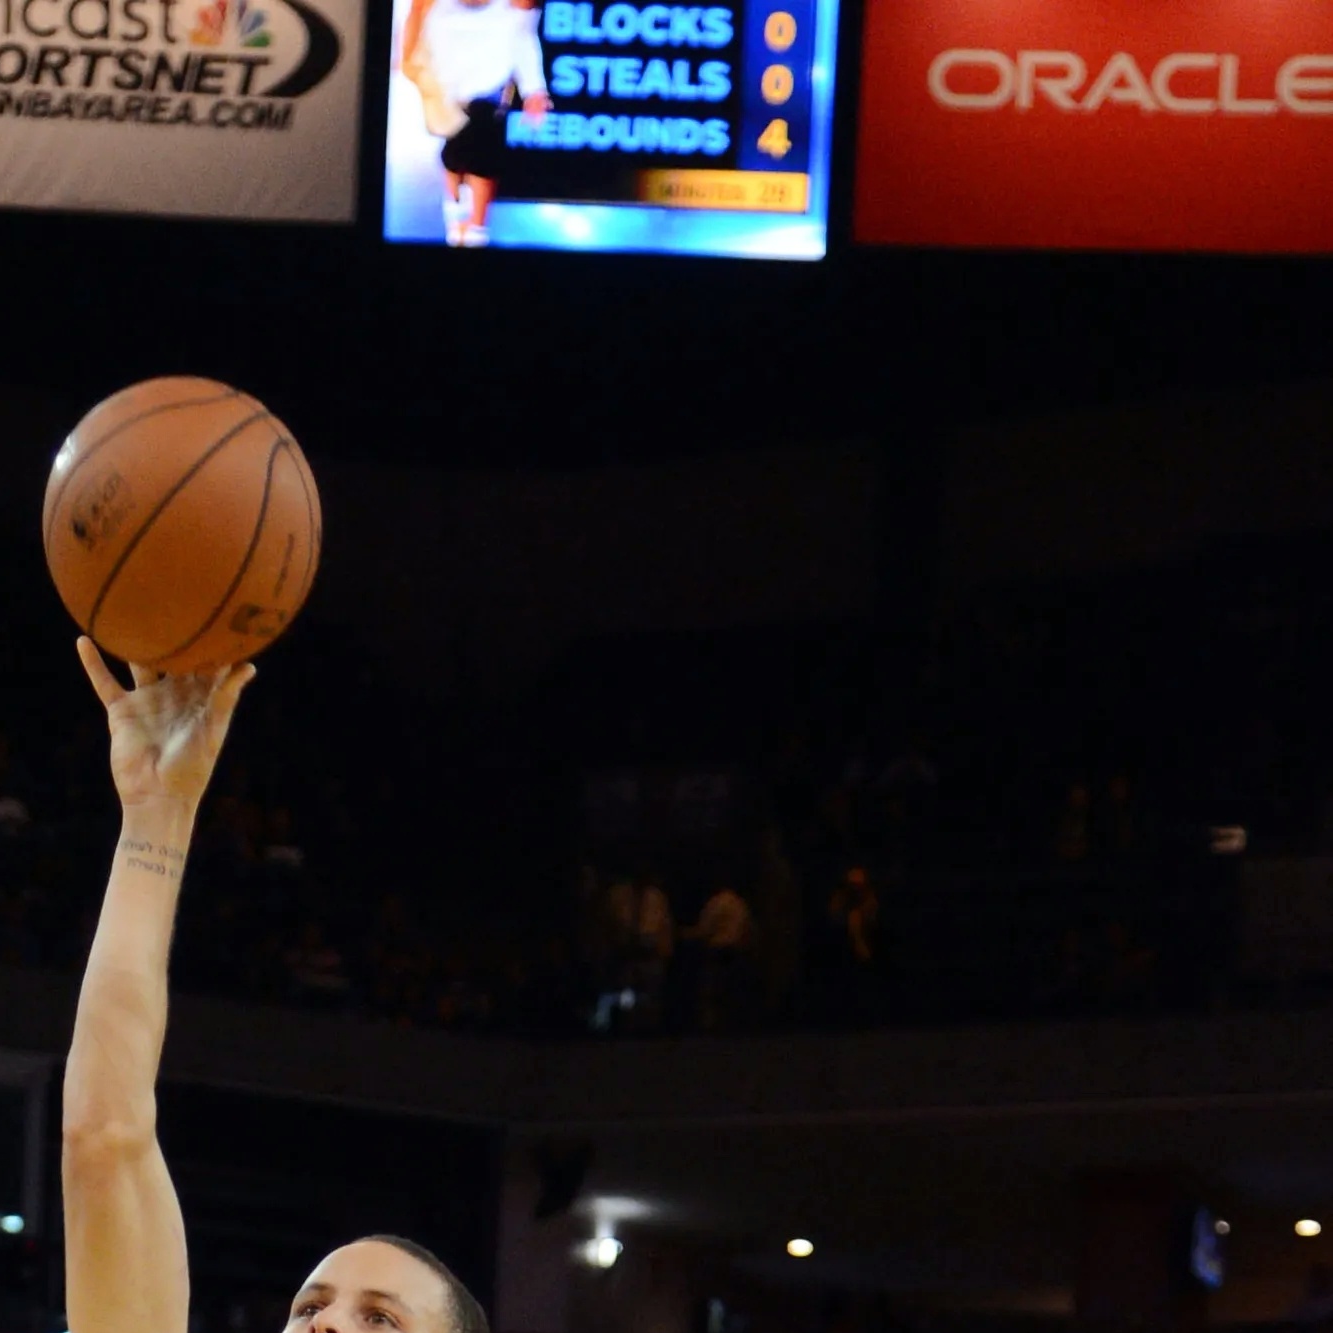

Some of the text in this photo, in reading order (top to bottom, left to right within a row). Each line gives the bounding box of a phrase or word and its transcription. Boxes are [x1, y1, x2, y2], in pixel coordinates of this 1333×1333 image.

[543, 1, 797, 52] BLOCKS 0
[551, 55, 794, 105] STEALS 0
[928, 48, 1333, 114] ORACLE
[757, 118, 793, 159] 4
